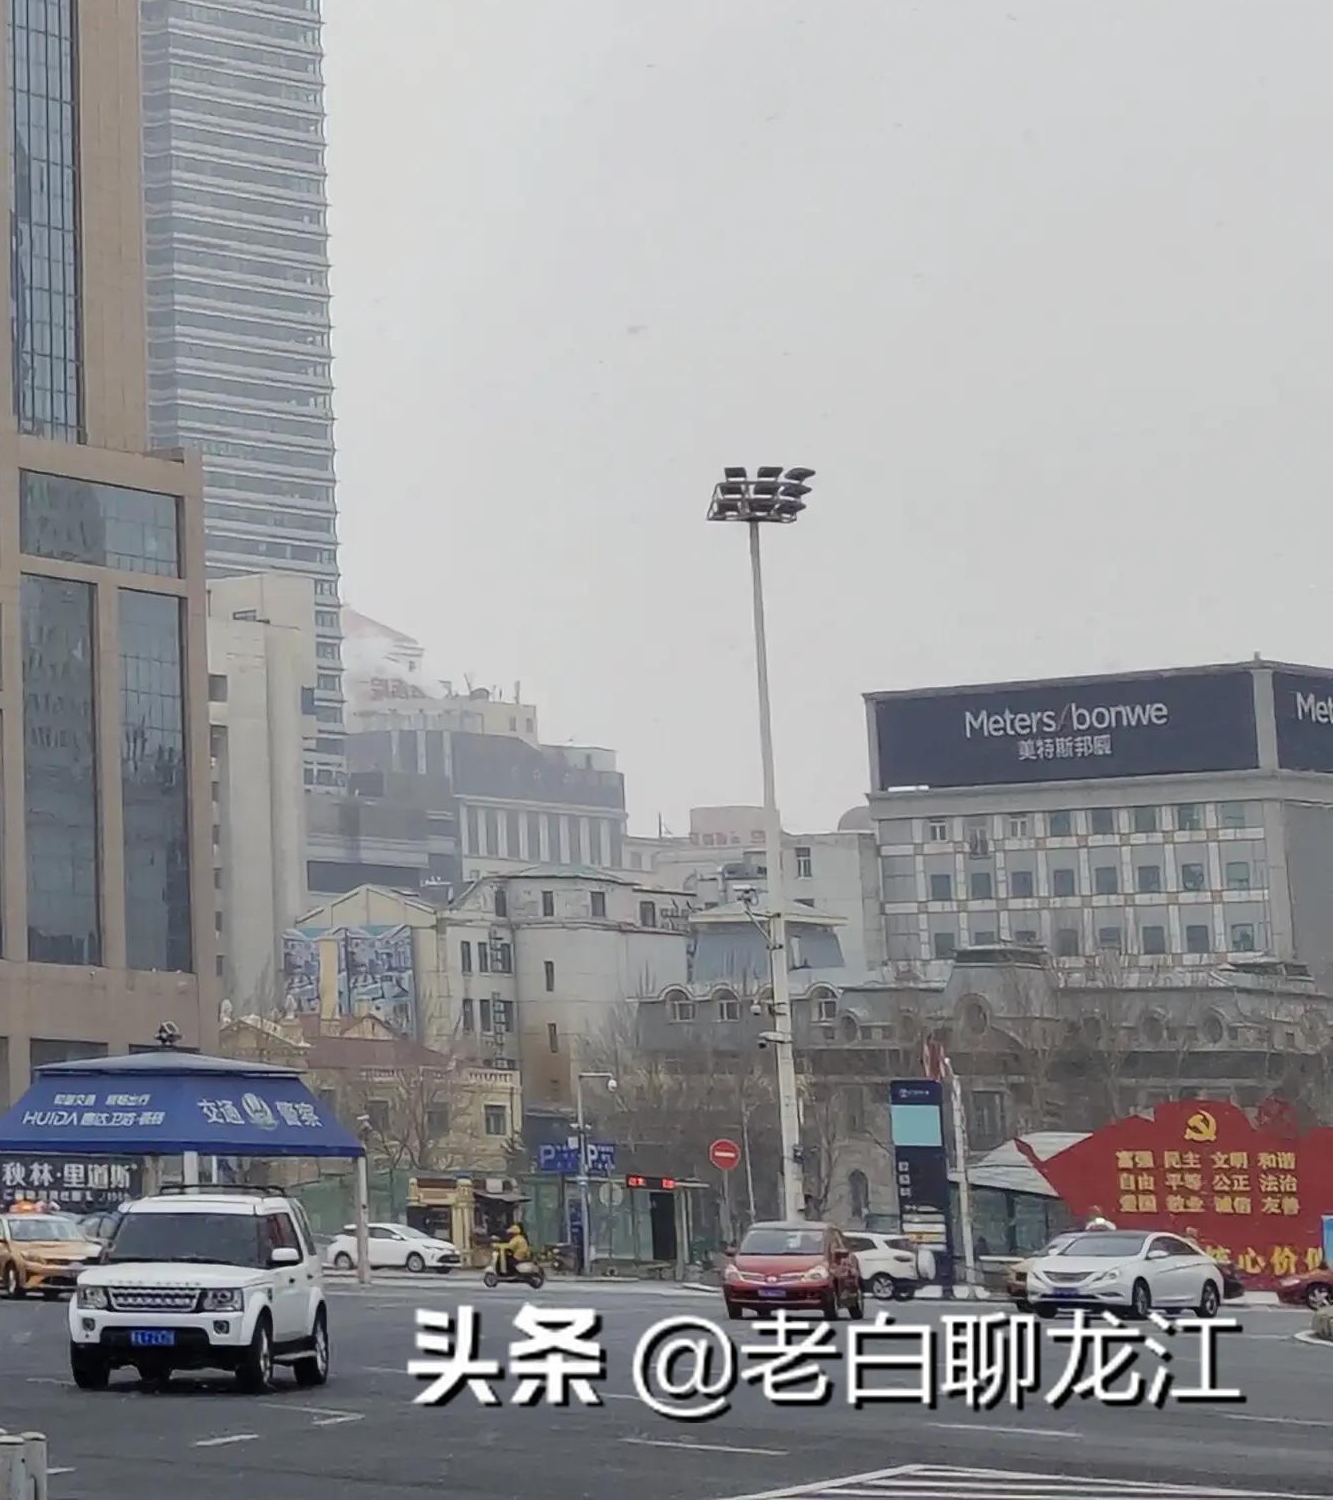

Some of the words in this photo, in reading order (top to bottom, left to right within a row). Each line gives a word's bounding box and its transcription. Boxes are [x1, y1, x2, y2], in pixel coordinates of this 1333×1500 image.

[22, 1111, 78, 1126] HUIDA
[197, 1098, 245, 1125] 交通
[275, 1100, 323, 1128] 警察
[1164, 1150, 1202, 1169] 民主
[1211, 1151, 1249, 1169] 文明
[1257, 1151, 1296, 1170] 和谐
[1119, 1173, 1155, 1191] 自由
[1165, 1173, 1202, 1191] 平等
[1212, 1174, 1251, 1192] 公正
[1259, 1174, 1297, 1192] 法治
